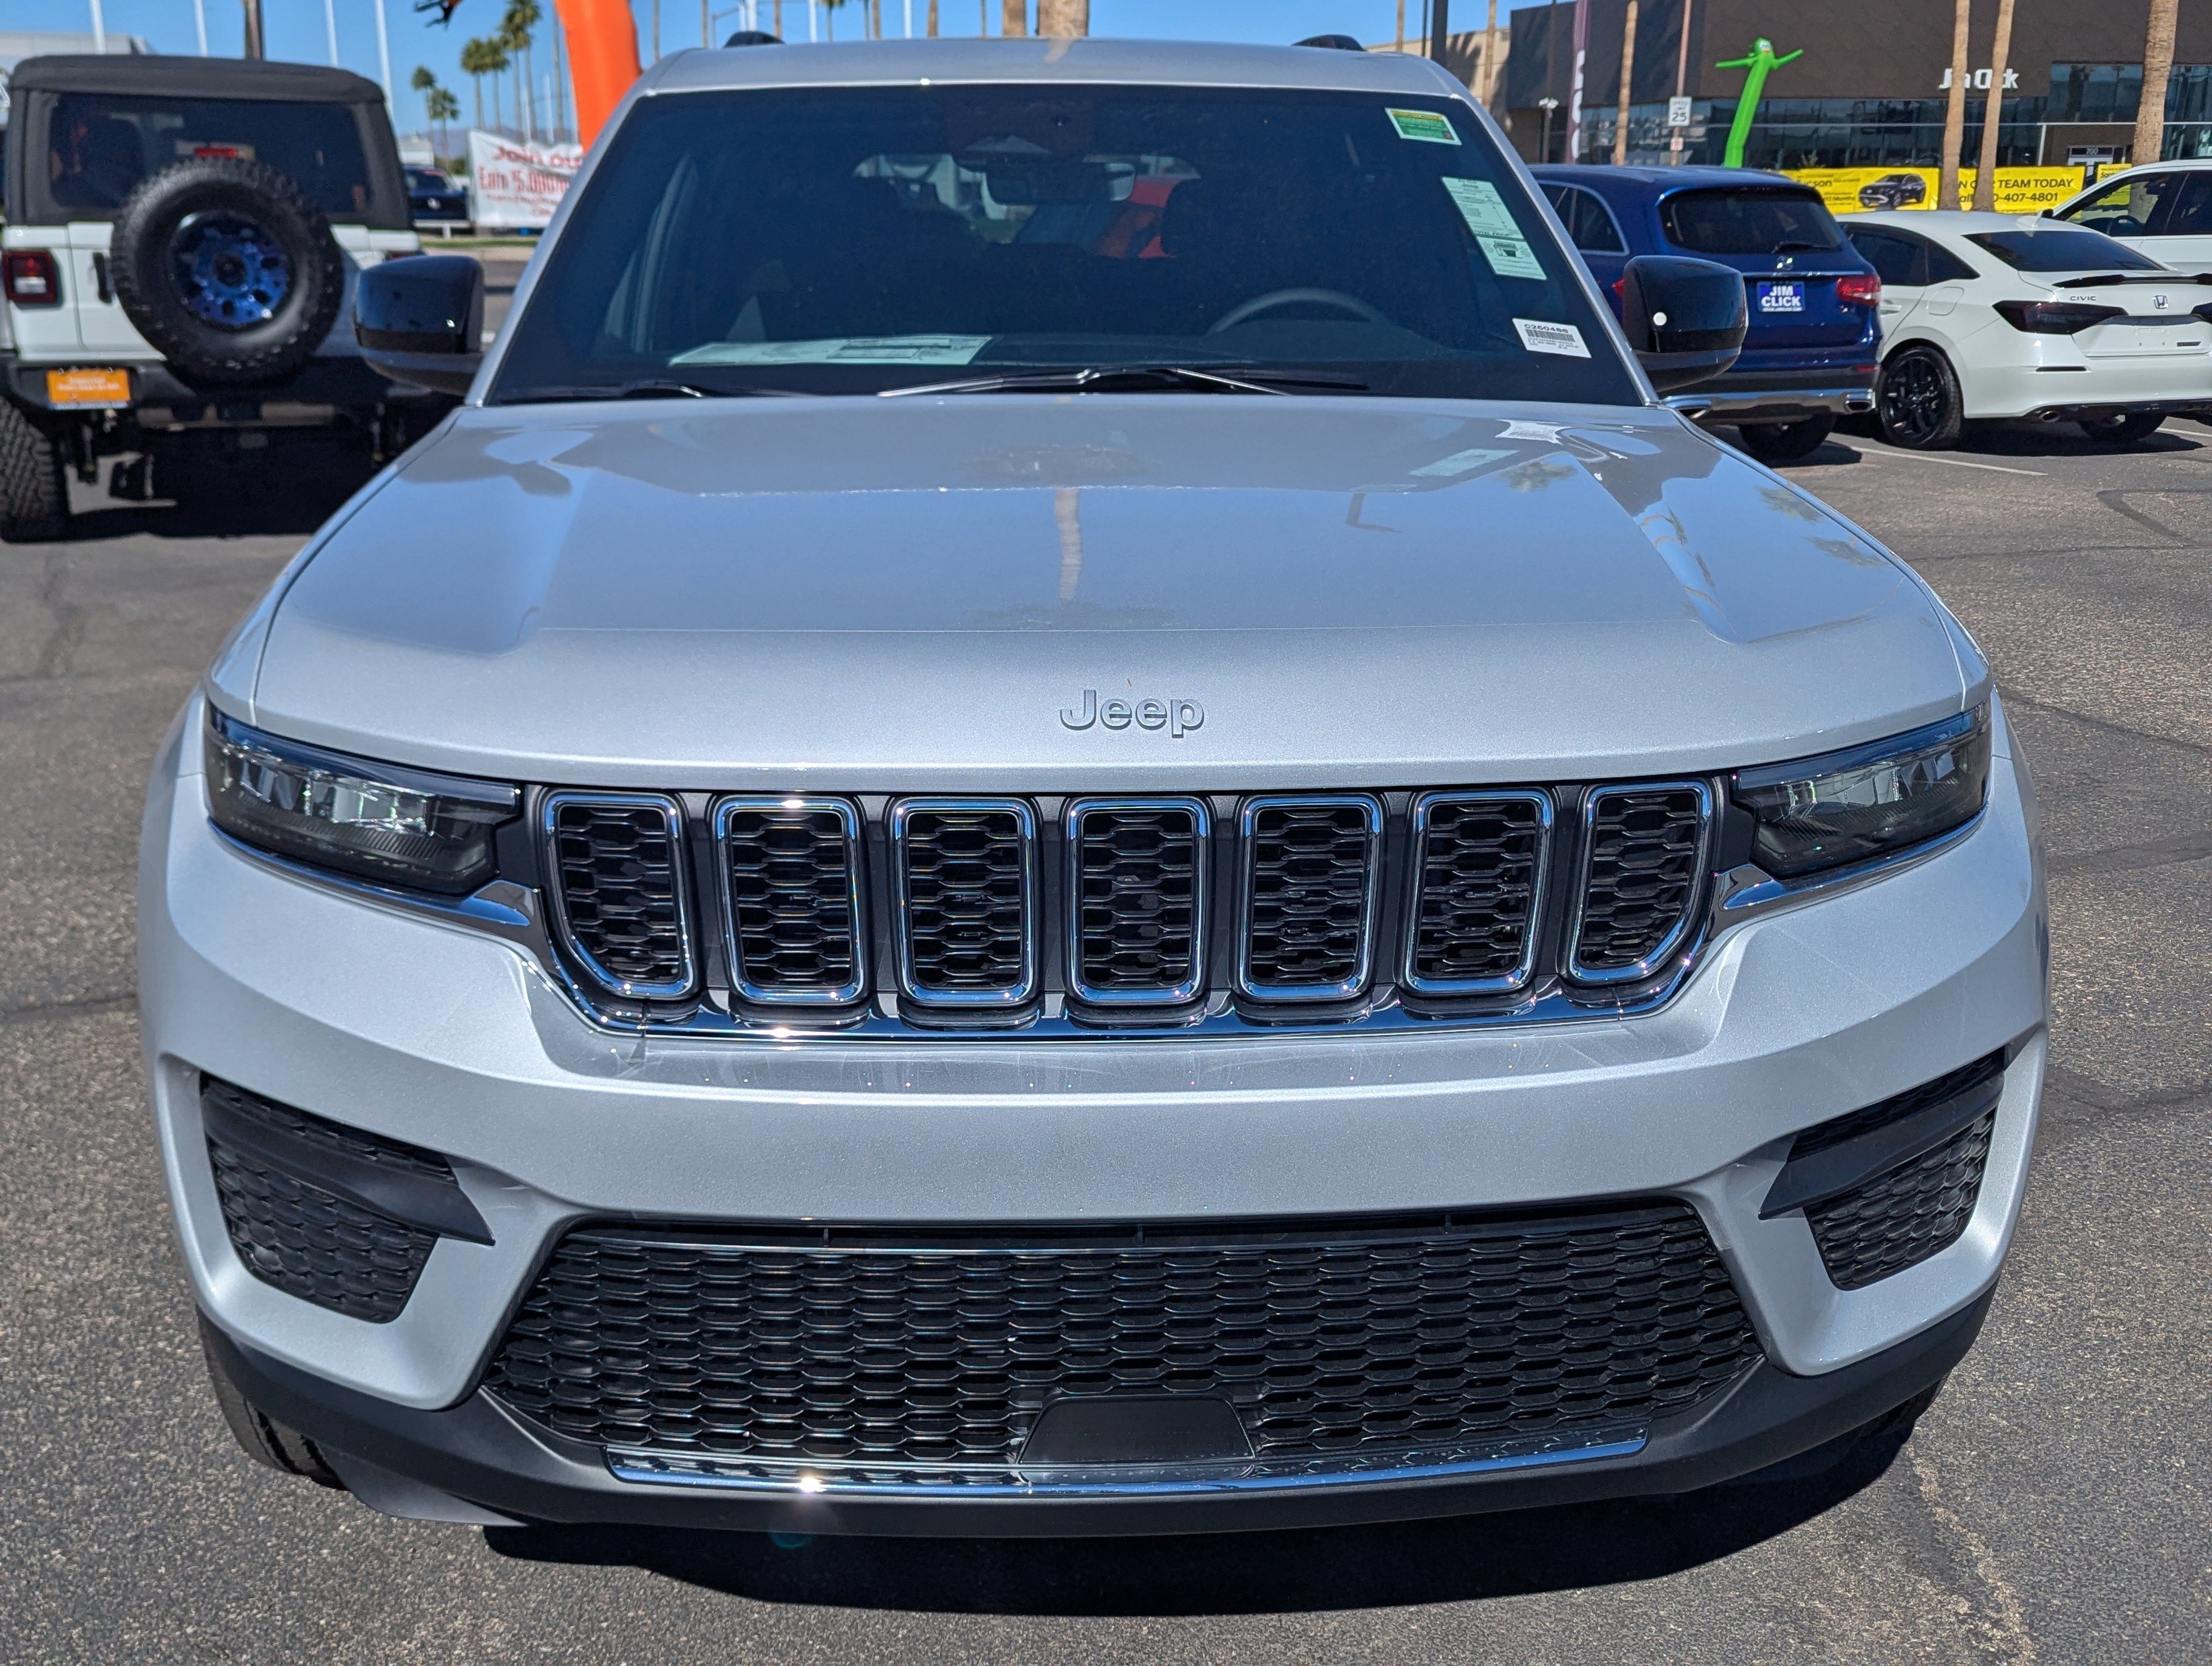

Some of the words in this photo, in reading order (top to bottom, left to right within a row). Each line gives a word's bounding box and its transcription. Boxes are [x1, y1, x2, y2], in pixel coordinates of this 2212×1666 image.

[1974, 68, 2019, 89] Clk
[1671, 112, 1687, 122] 25
[1999, 179, 2030, 189] TEAM
[2033, 178, 2074, 188] TODAY
[1959, 193, 1974, 202] all
[1993, 192, 2058, 202] 0-407-4801
[1769, 285, 1794, 296] JIM
[1761, 296, 1801, 306] CLICK
[1060, 689, 1205, 739] Jeep
